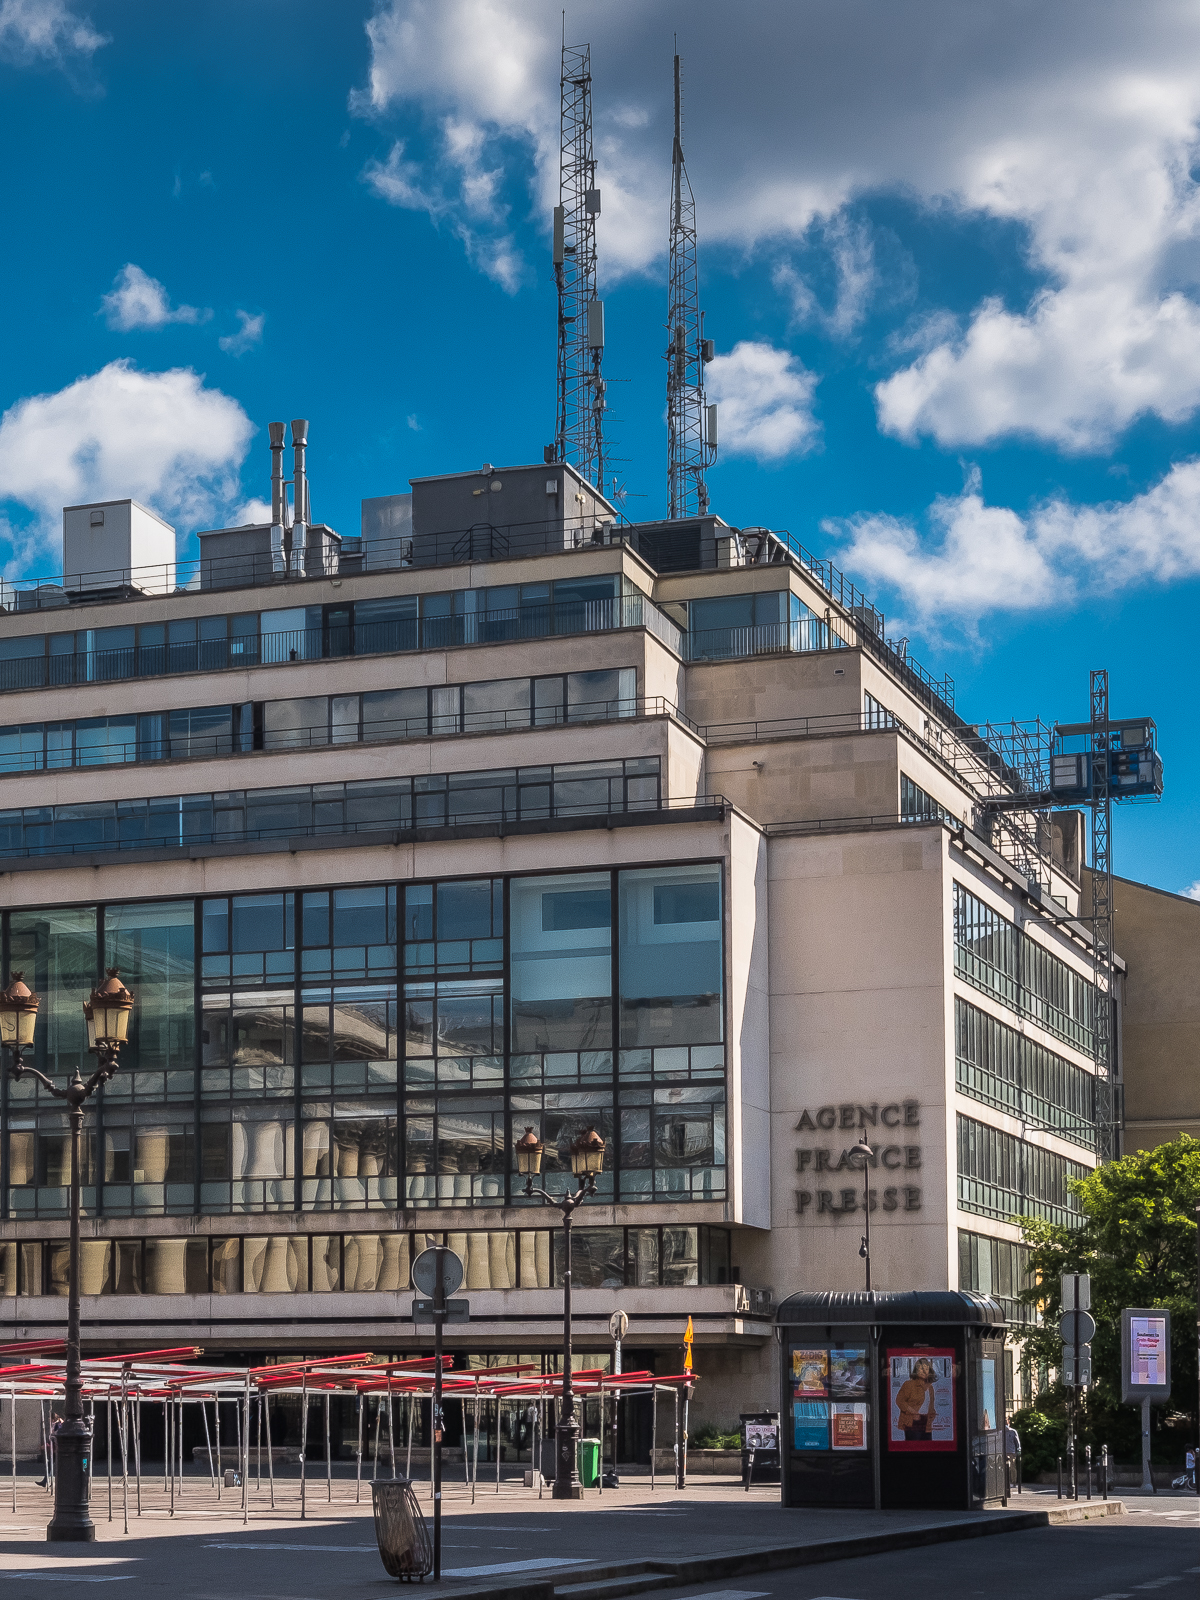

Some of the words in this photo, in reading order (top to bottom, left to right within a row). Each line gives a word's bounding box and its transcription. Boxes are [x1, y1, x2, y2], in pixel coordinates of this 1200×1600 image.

[795, 1100, 920, 1131] AGENCE
[795, 1145, 921, 1171] FRANCE
[795, 1187, 921, 1214] PRESSE
